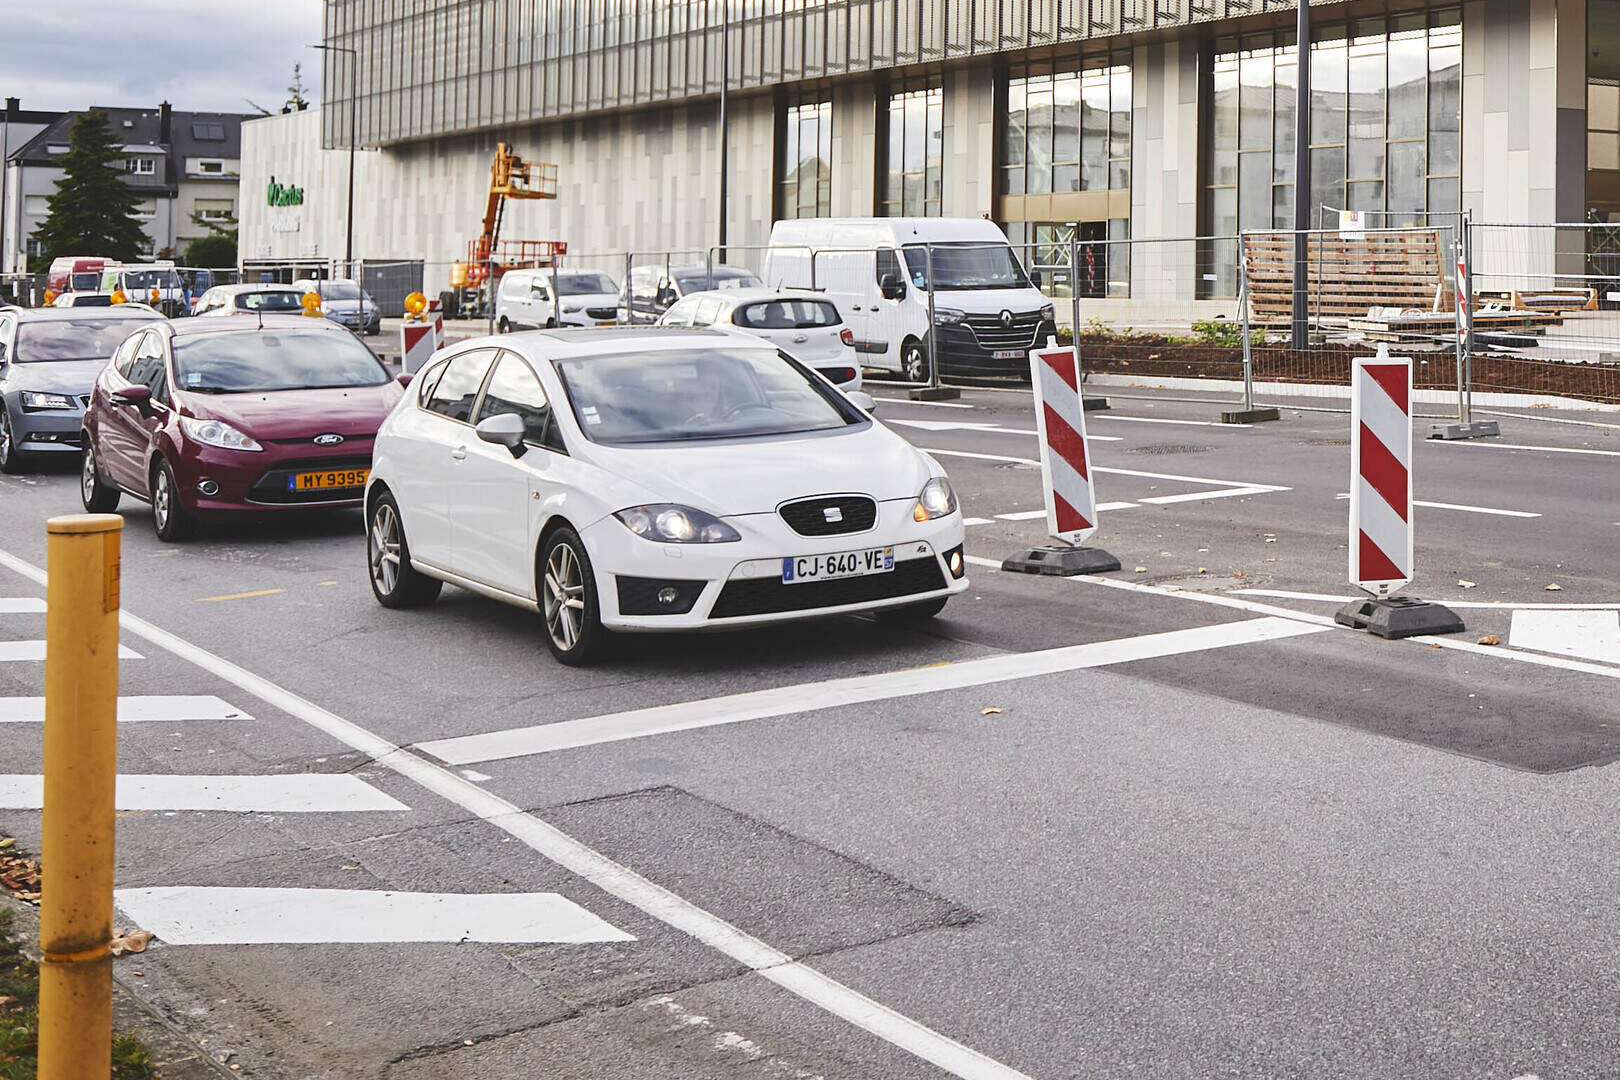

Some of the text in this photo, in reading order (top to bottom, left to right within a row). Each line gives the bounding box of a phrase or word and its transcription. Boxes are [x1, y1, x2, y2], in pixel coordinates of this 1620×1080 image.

[303, 471, 365, 488] MY 9395
[796, 549, 883, 578] CJ-640-VE
